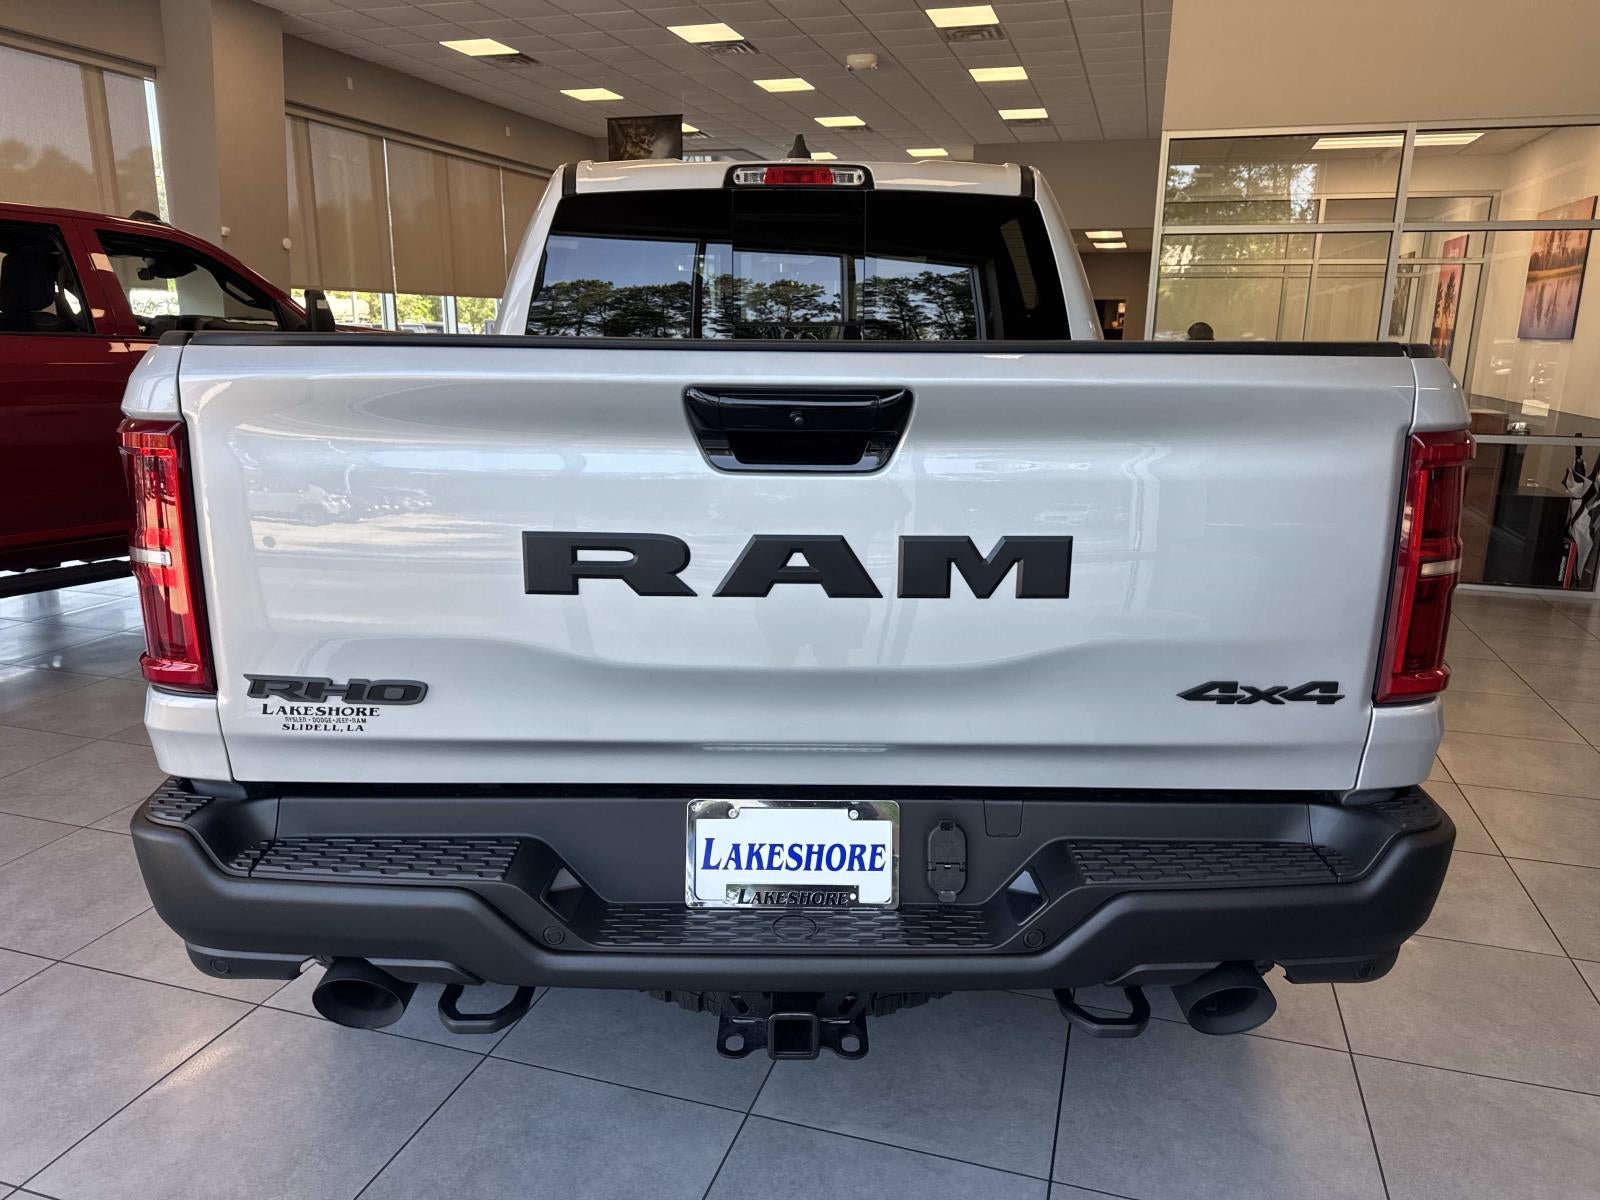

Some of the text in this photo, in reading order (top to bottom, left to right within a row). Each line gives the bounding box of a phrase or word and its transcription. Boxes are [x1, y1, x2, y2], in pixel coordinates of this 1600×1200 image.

[522, 531, 1073, 599] RAM
[243, 673, 429, 706] RHO
[1176, 680, 1346, 705] 4x4
[261, 703, 380, 717] LAKESHORE
[346, 724, 364, 732] LA
[701, 837, 887, 872] LAKESHORE
[736, 888, 850, 906] LAKESHORE
